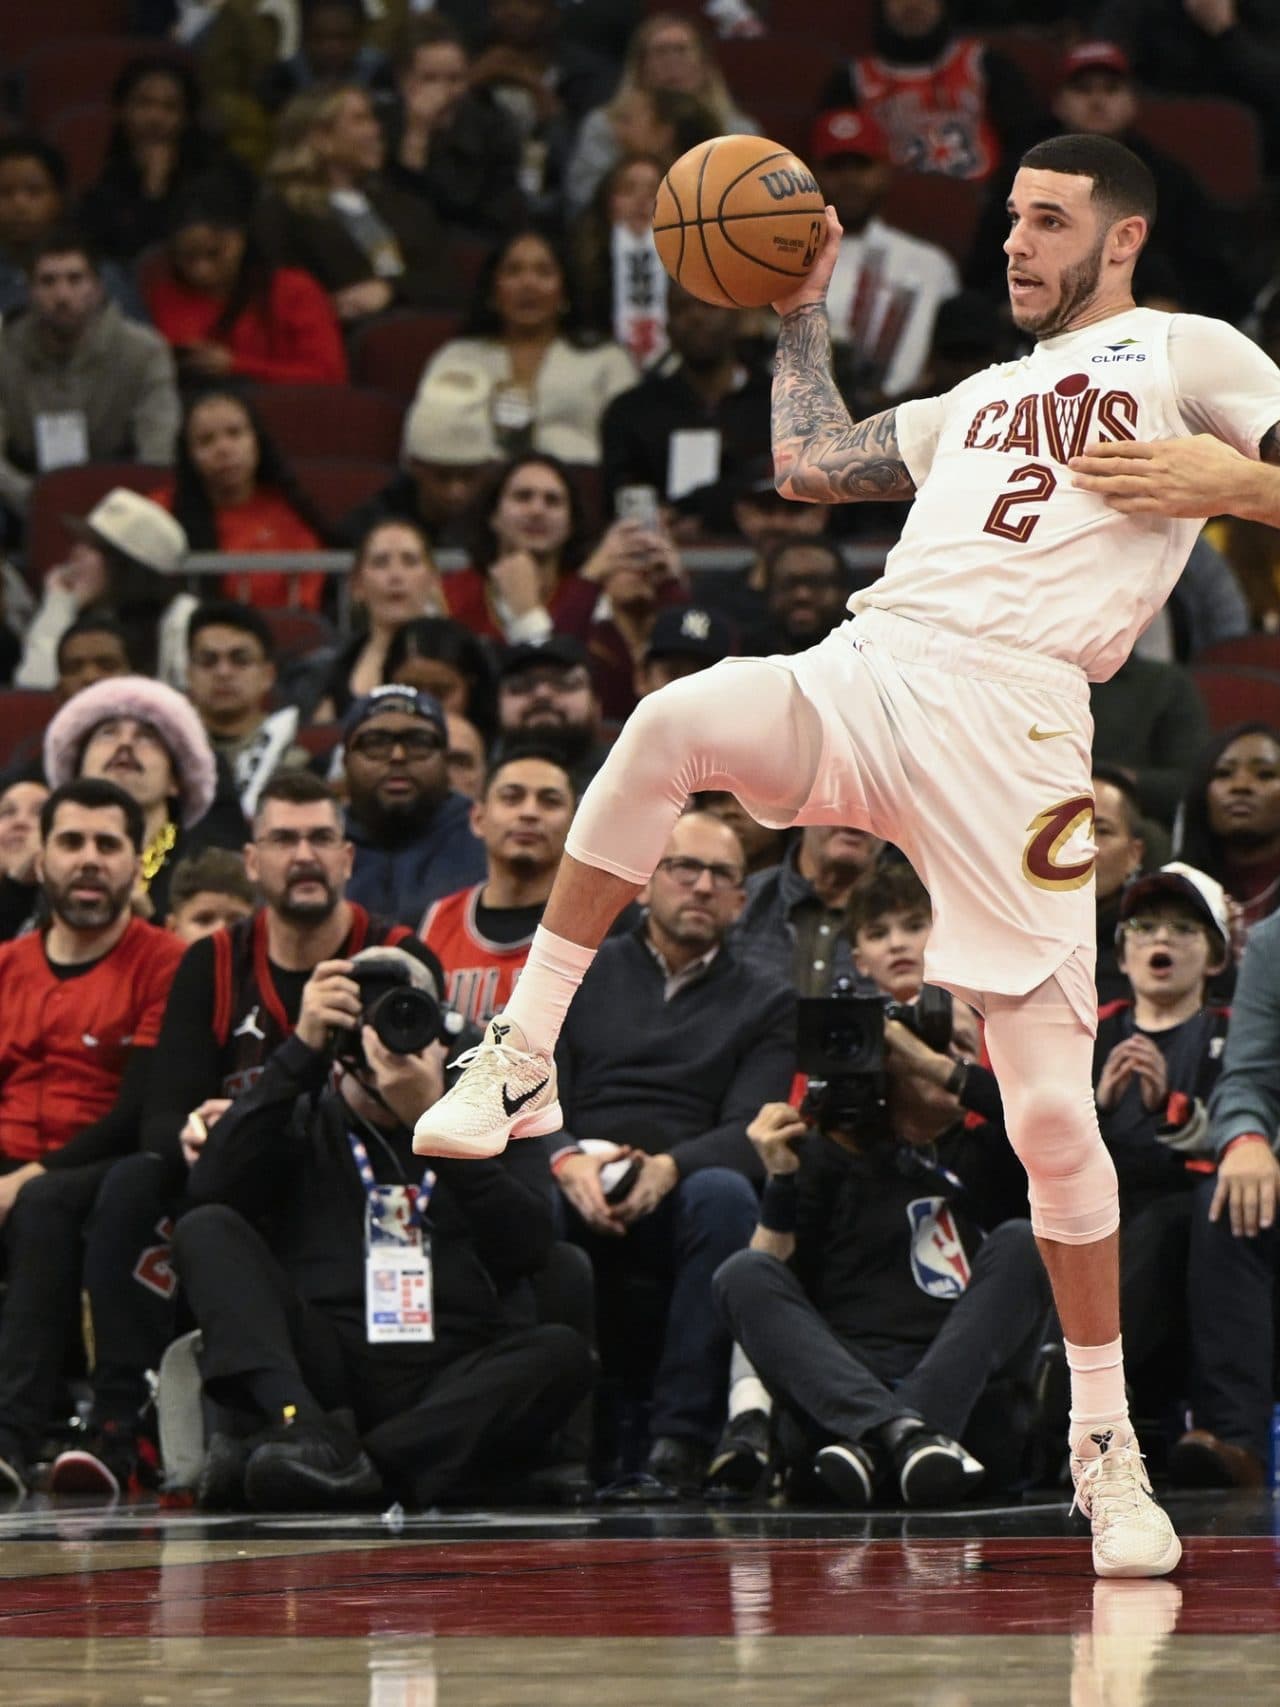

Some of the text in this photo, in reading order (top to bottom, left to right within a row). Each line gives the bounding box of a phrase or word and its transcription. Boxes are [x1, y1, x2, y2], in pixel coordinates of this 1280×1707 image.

[1091, 353, 1146, 364] CLIFFS
[963, 387, 1139, 465] CAVS
[983, 463, 1058, 543] 2
